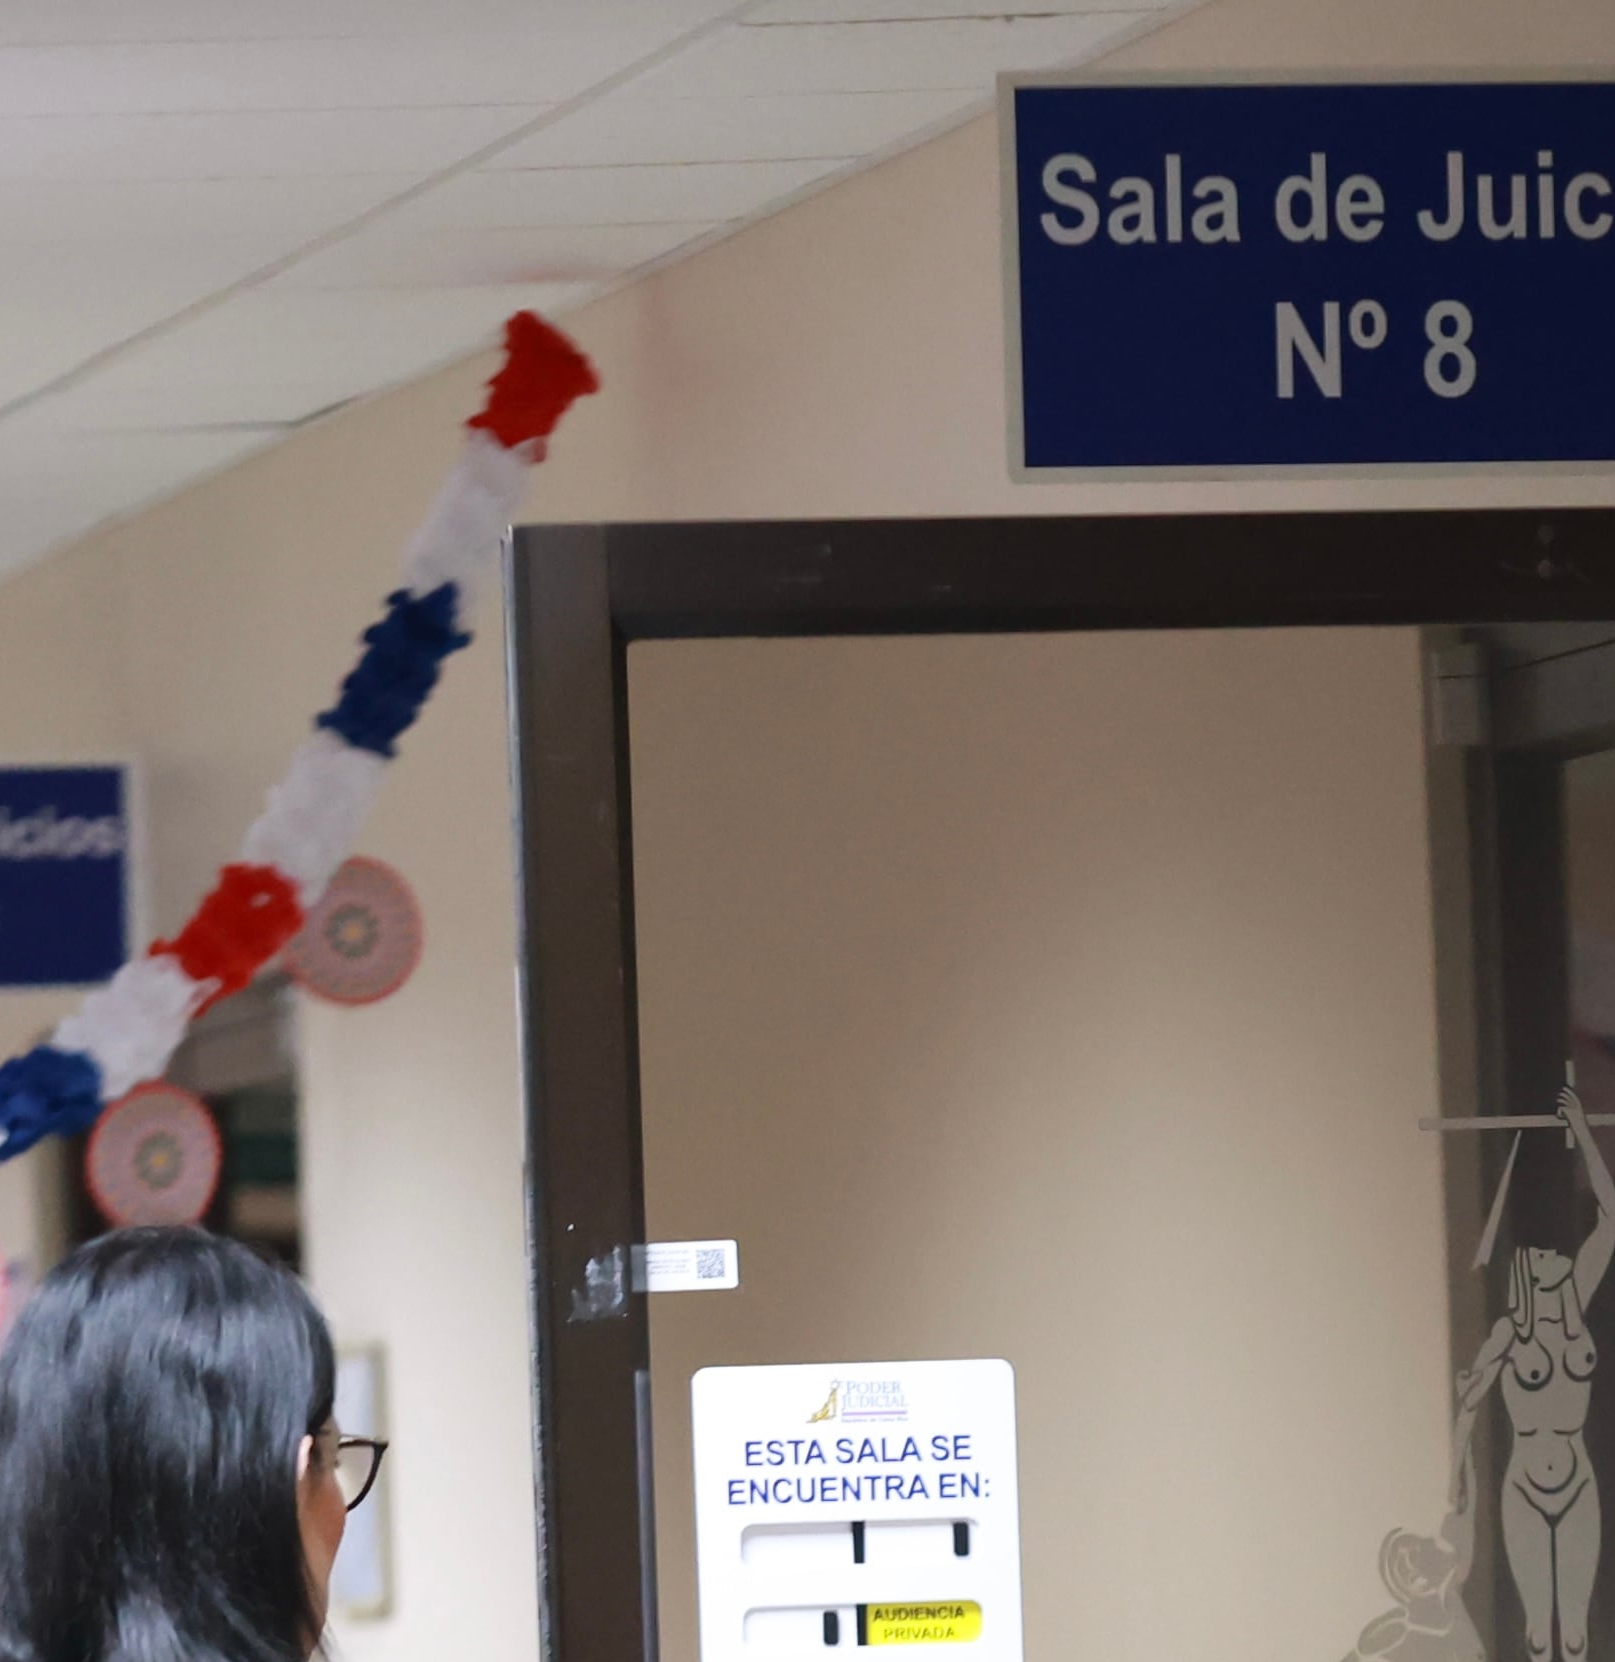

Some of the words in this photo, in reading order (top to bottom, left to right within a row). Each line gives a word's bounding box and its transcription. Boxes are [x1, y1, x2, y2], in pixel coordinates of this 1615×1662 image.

[1039, 153, 1241, 247] Sala
[1275, 152, 1385, 242] de
[1423, 299, 1477, 398] 8
[841, 1394, 908, 1411] JUDICIAL
[745, 1439, 826, 1467] ESTA
[836, 1436, 922, 1464] SALA
[931, 1435, 972, 1462] SE
[728, 1475, 929, 1506] ENCUENTRA
[939, 1472, 991, 1499] EN:
[873, 1604, 966, 1622] AUDIENCIA
[883, 1626, 956, 1640] PRIVADA
